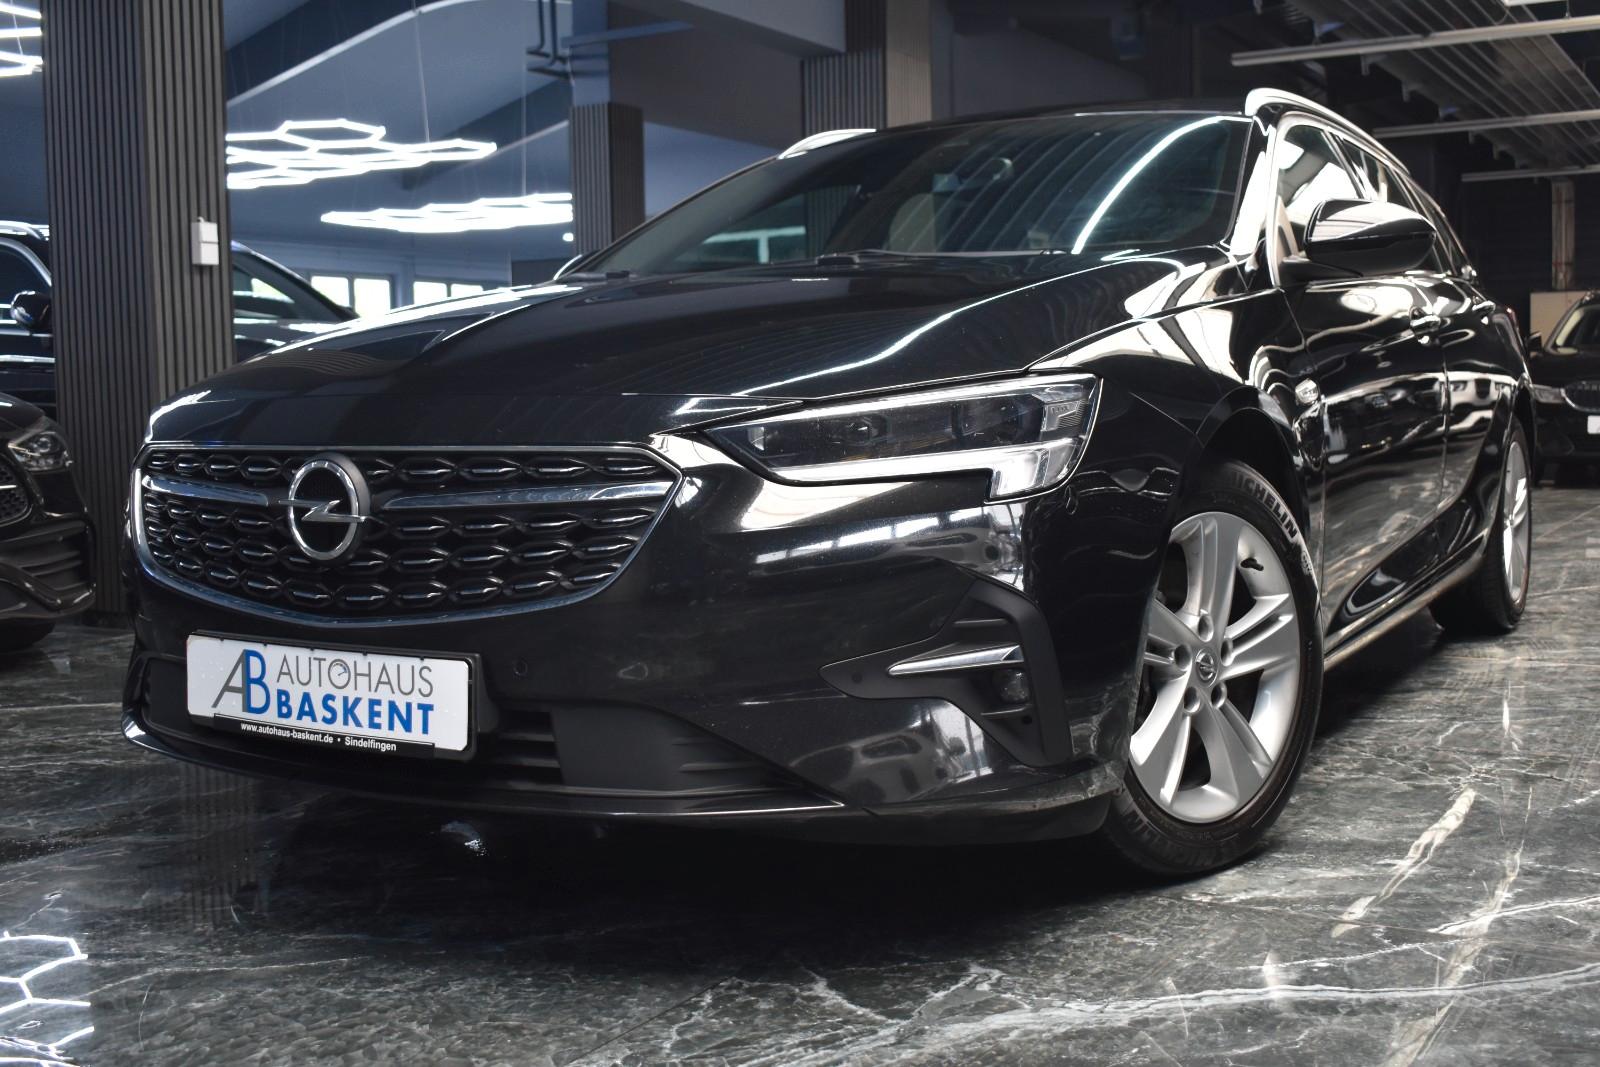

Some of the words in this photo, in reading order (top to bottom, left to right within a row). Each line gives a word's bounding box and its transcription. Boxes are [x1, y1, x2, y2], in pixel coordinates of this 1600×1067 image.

[277, 654, 434, 698] AUTOHAUS
[277, 688, 434, 735] BASKENT
[240, 722, 334, 744] www.autohaus-baskent.de
[344, 736, 397, 752] Sindelfingen
